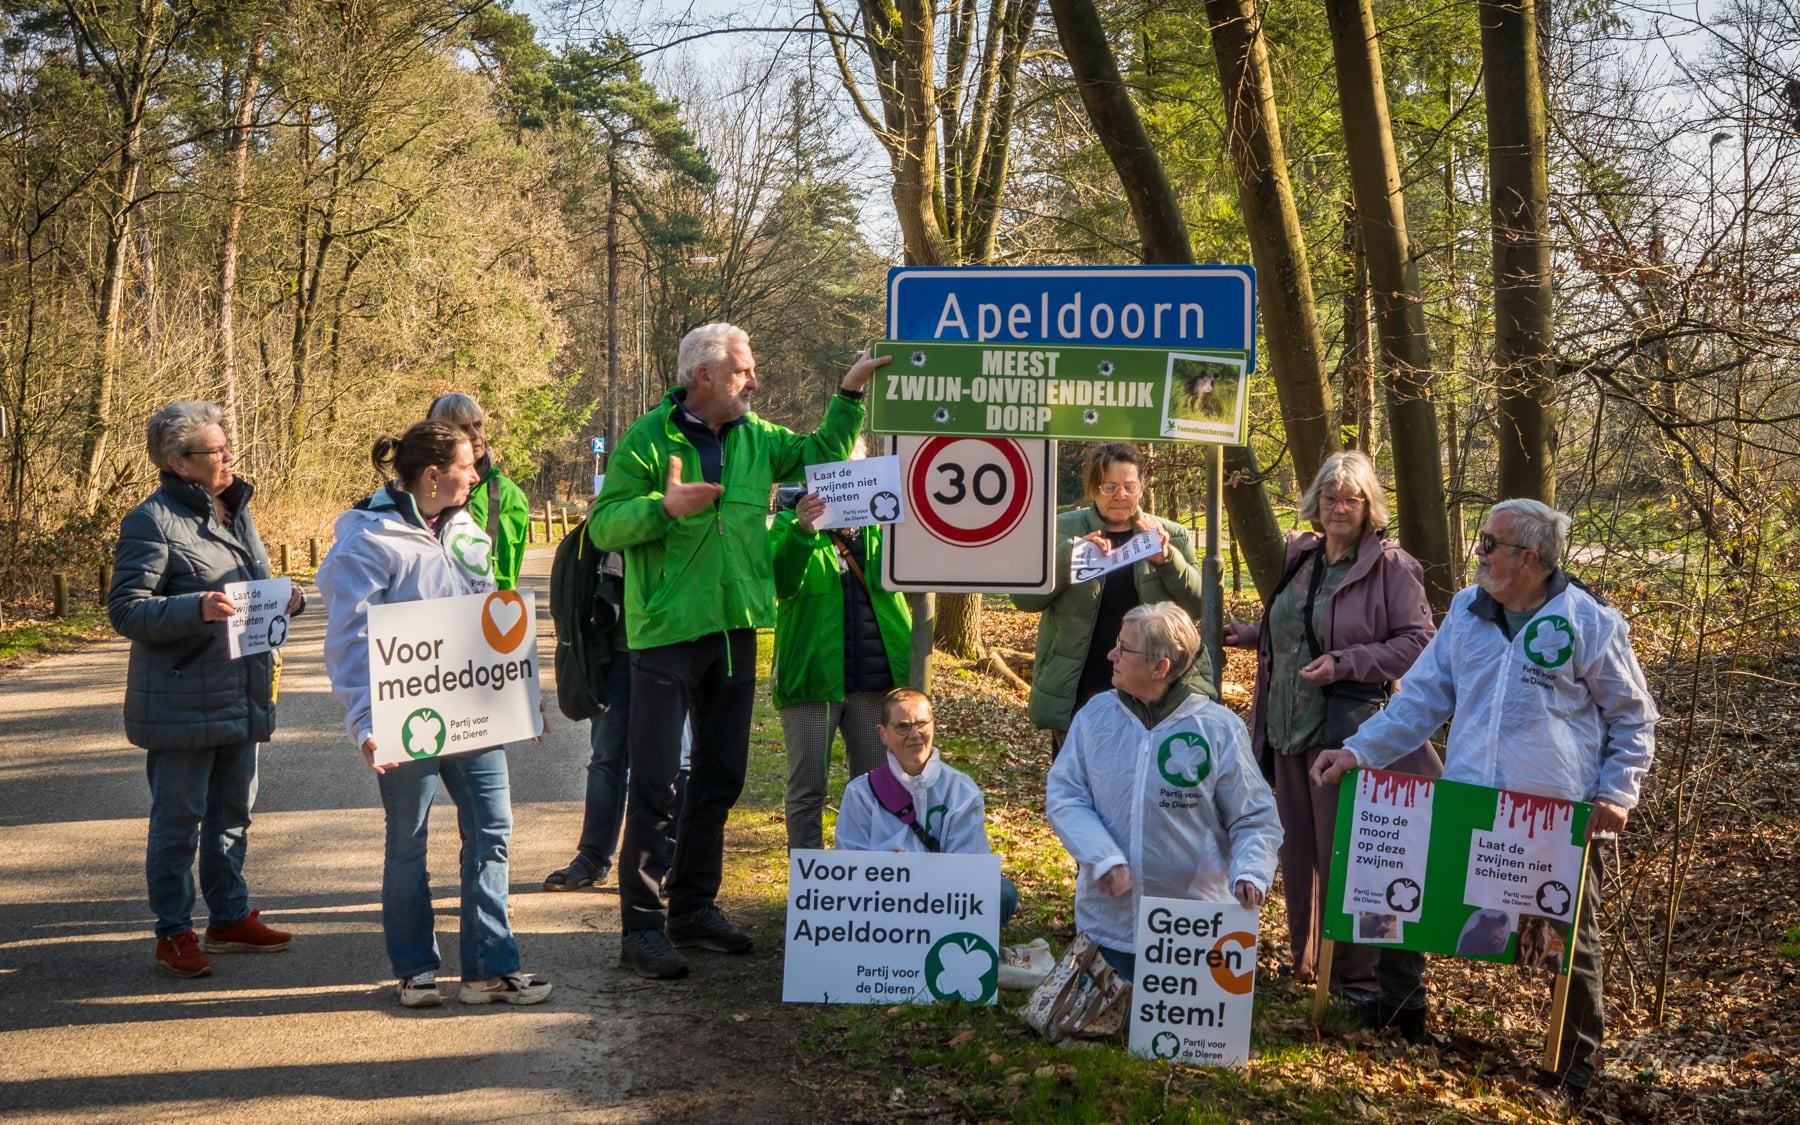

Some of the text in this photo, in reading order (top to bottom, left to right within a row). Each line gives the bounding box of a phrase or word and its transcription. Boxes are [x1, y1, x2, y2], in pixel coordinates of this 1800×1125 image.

[934, 291, 1204, 341] Apeldoorn
[982, 350, 1060, 377] MEEST
[886, 375, 1154, 408] ZWIJN-ONVRIENDELIJK
[985, 405, 1052, 432] DORP
[813, 468, 852, 481] Laat de
[815, 477, 878, 493] zwijnen niet
[932, 462, 1008, 506] 30
[823, 493, 860, 504] hieten
[232, 588, 262, 601] Laat de
[234, 600, 278, 615] wijnen niet
[232, 616, 264, 628] schieten
[376, 636, 444, 666] Voor
[378, 658, 532, 701] mededogen
[1522, 664, 1557, 681] Partij voor
[1521, 676, 1554, 691] de Dieren
[450, 715, 489, 729] Partij voor
[450, 728, 488, 742] de Dieren
[1160, 788, 1183, 799] Partij
[1159, 800, 1198, 809] de Dieren
[1360, 810, 1409, 827] Stop de
[1359, 826, 1400, 840] moord
[1357, 842, 1406, 856] op deze
[1478, 837, 1525, 855] Laat de
[797, 858, 911, 882] Voor een
[1356, 855, 1404, 870] zwijnen
[1476, 853, 1553, 873] zwijnen niet
[1474, 866, 1528, 884] schieten
[1353, 887, 1370, 897] Partij
[1503, 890, 1520, 899] Partij
[795, 888, 984, 920] diervriendelijk
[1361, 896, 1382, 905] Dieren
[1511, 898, 1531, 907] Dieren
[1147, 907, 1224, 938] Geef
[793, 919, 931, 946] Apeldoorn
[1144, 937, 1242, 970] dieren
[856, 965, 920, 980] Partij voor
[855, 982, 915, 995] de Dieren
[1142, 974, 1197, 996] een
[1139, 1000, 1226, 1028] stem!
[1183, 1037, 1227, 1049] Partij voor
[1182, 1049, 1223, 1059] de Dieren
